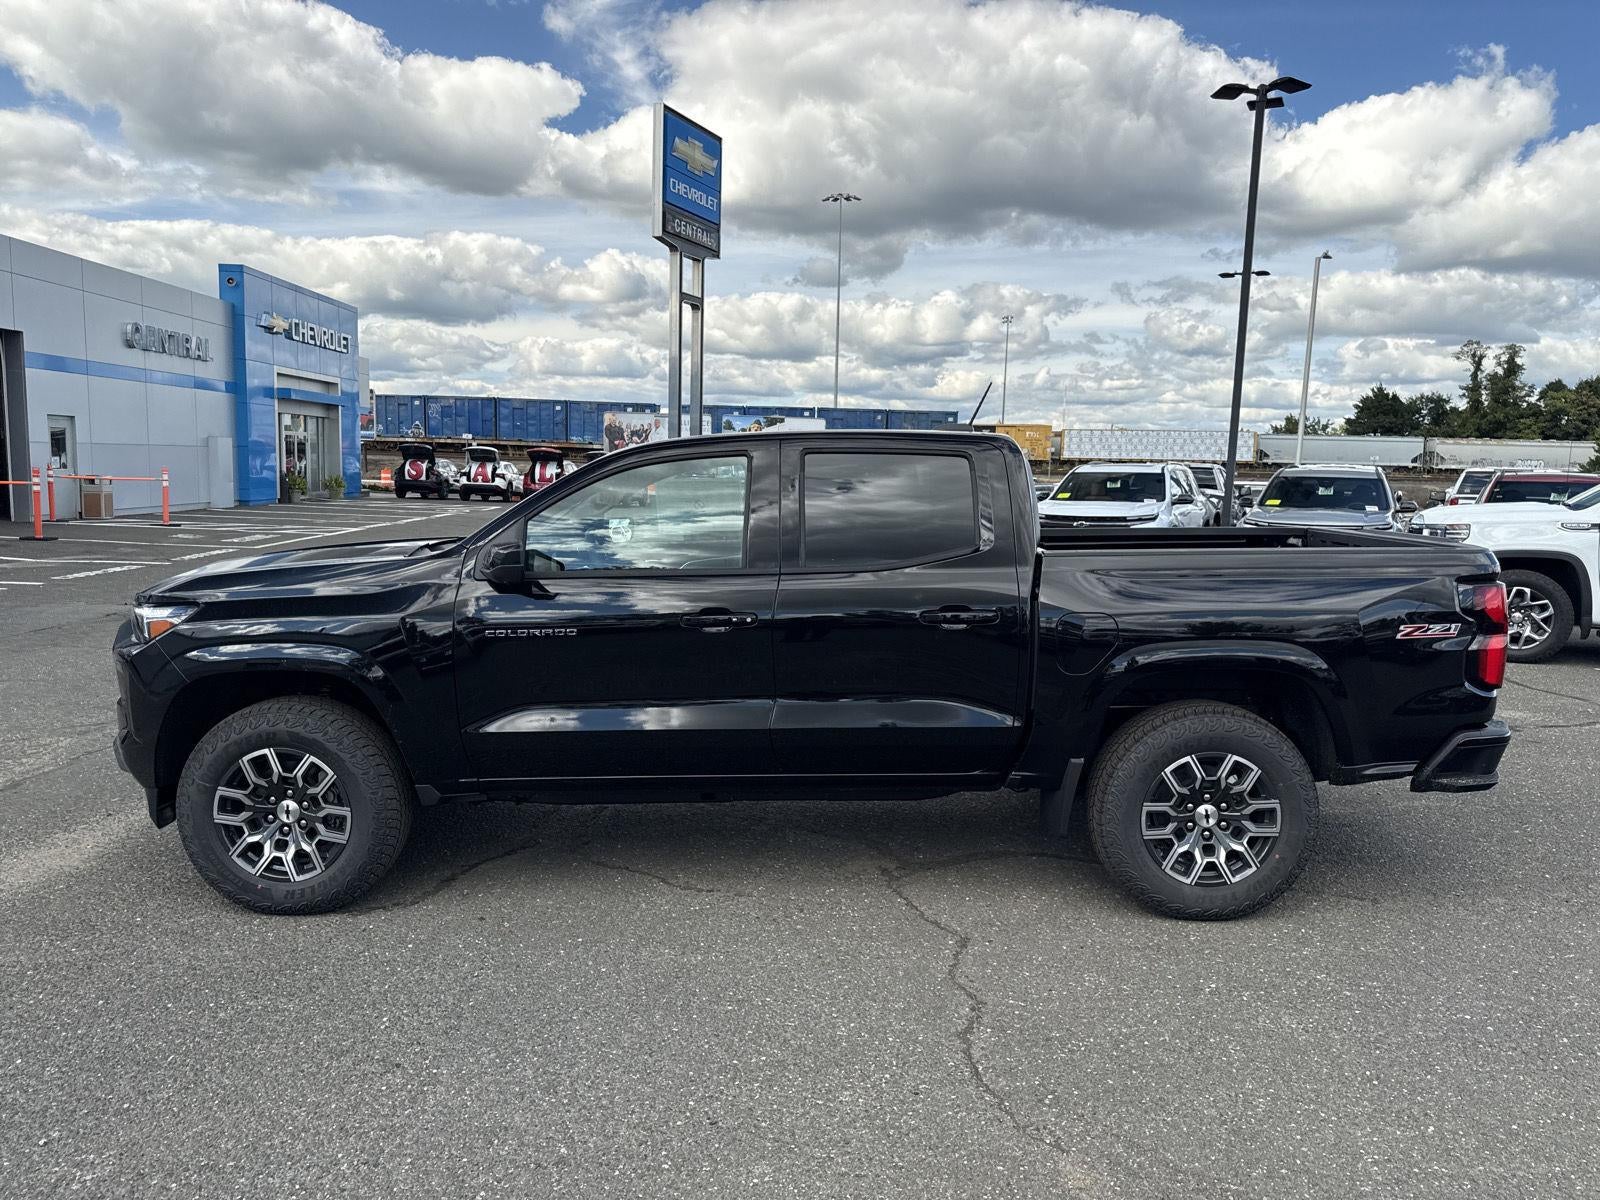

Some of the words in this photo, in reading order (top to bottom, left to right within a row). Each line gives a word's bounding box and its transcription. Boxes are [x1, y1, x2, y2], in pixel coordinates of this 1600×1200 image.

[670, 178, 717, 211] CHEVROLET
[675, 219, 712, 245] CENTRAL
[124, 321, 213, 362] CENTRAL
[290, 318, 352, 354] CHEVROLET
[407, 459, 424, 480] S
[473, 462, 491, 483] A
[484, 628, 578, 637] COLORADO
[1395, 623, 1462, 640] Z71
